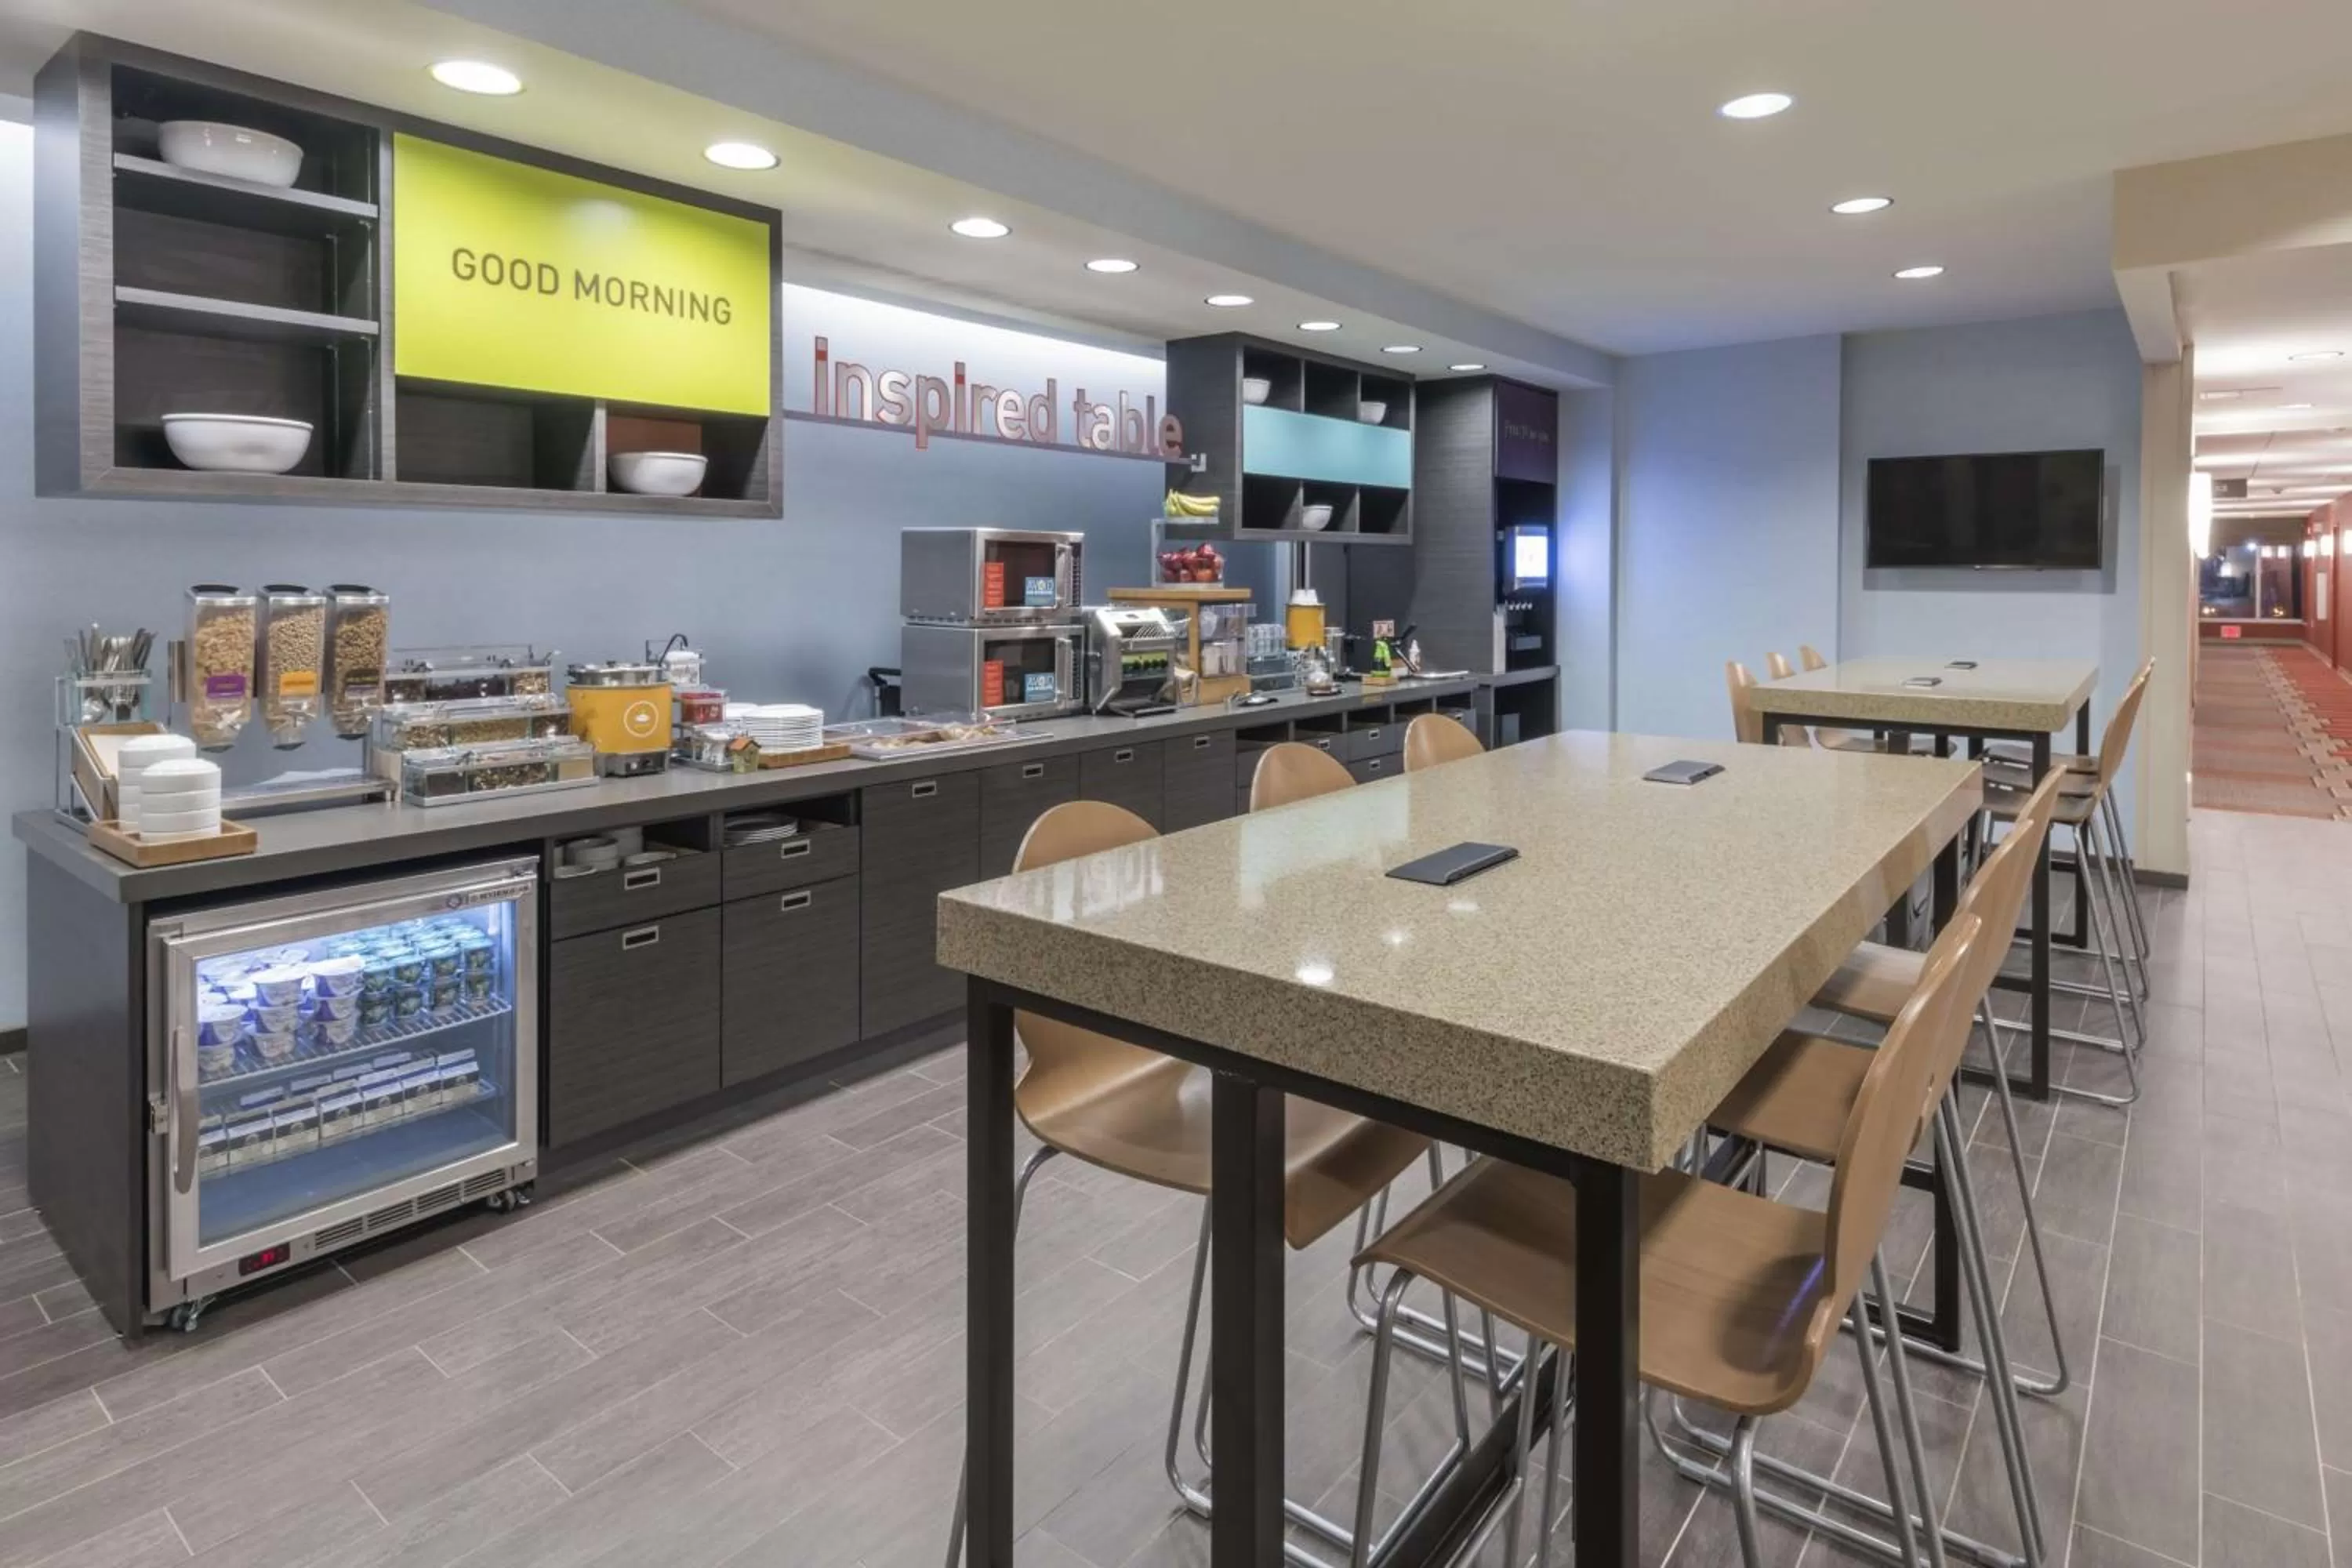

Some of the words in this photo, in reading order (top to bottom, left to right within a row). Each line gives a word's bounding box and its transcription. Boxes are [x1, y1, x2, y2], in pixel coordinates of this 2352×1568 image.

[452, 247, 560, 296] GOOD
[574, 269, 732, 325] MORNING
[815, 336, 1058, 452] inspired
[1073, 387, 1184, 457] table
